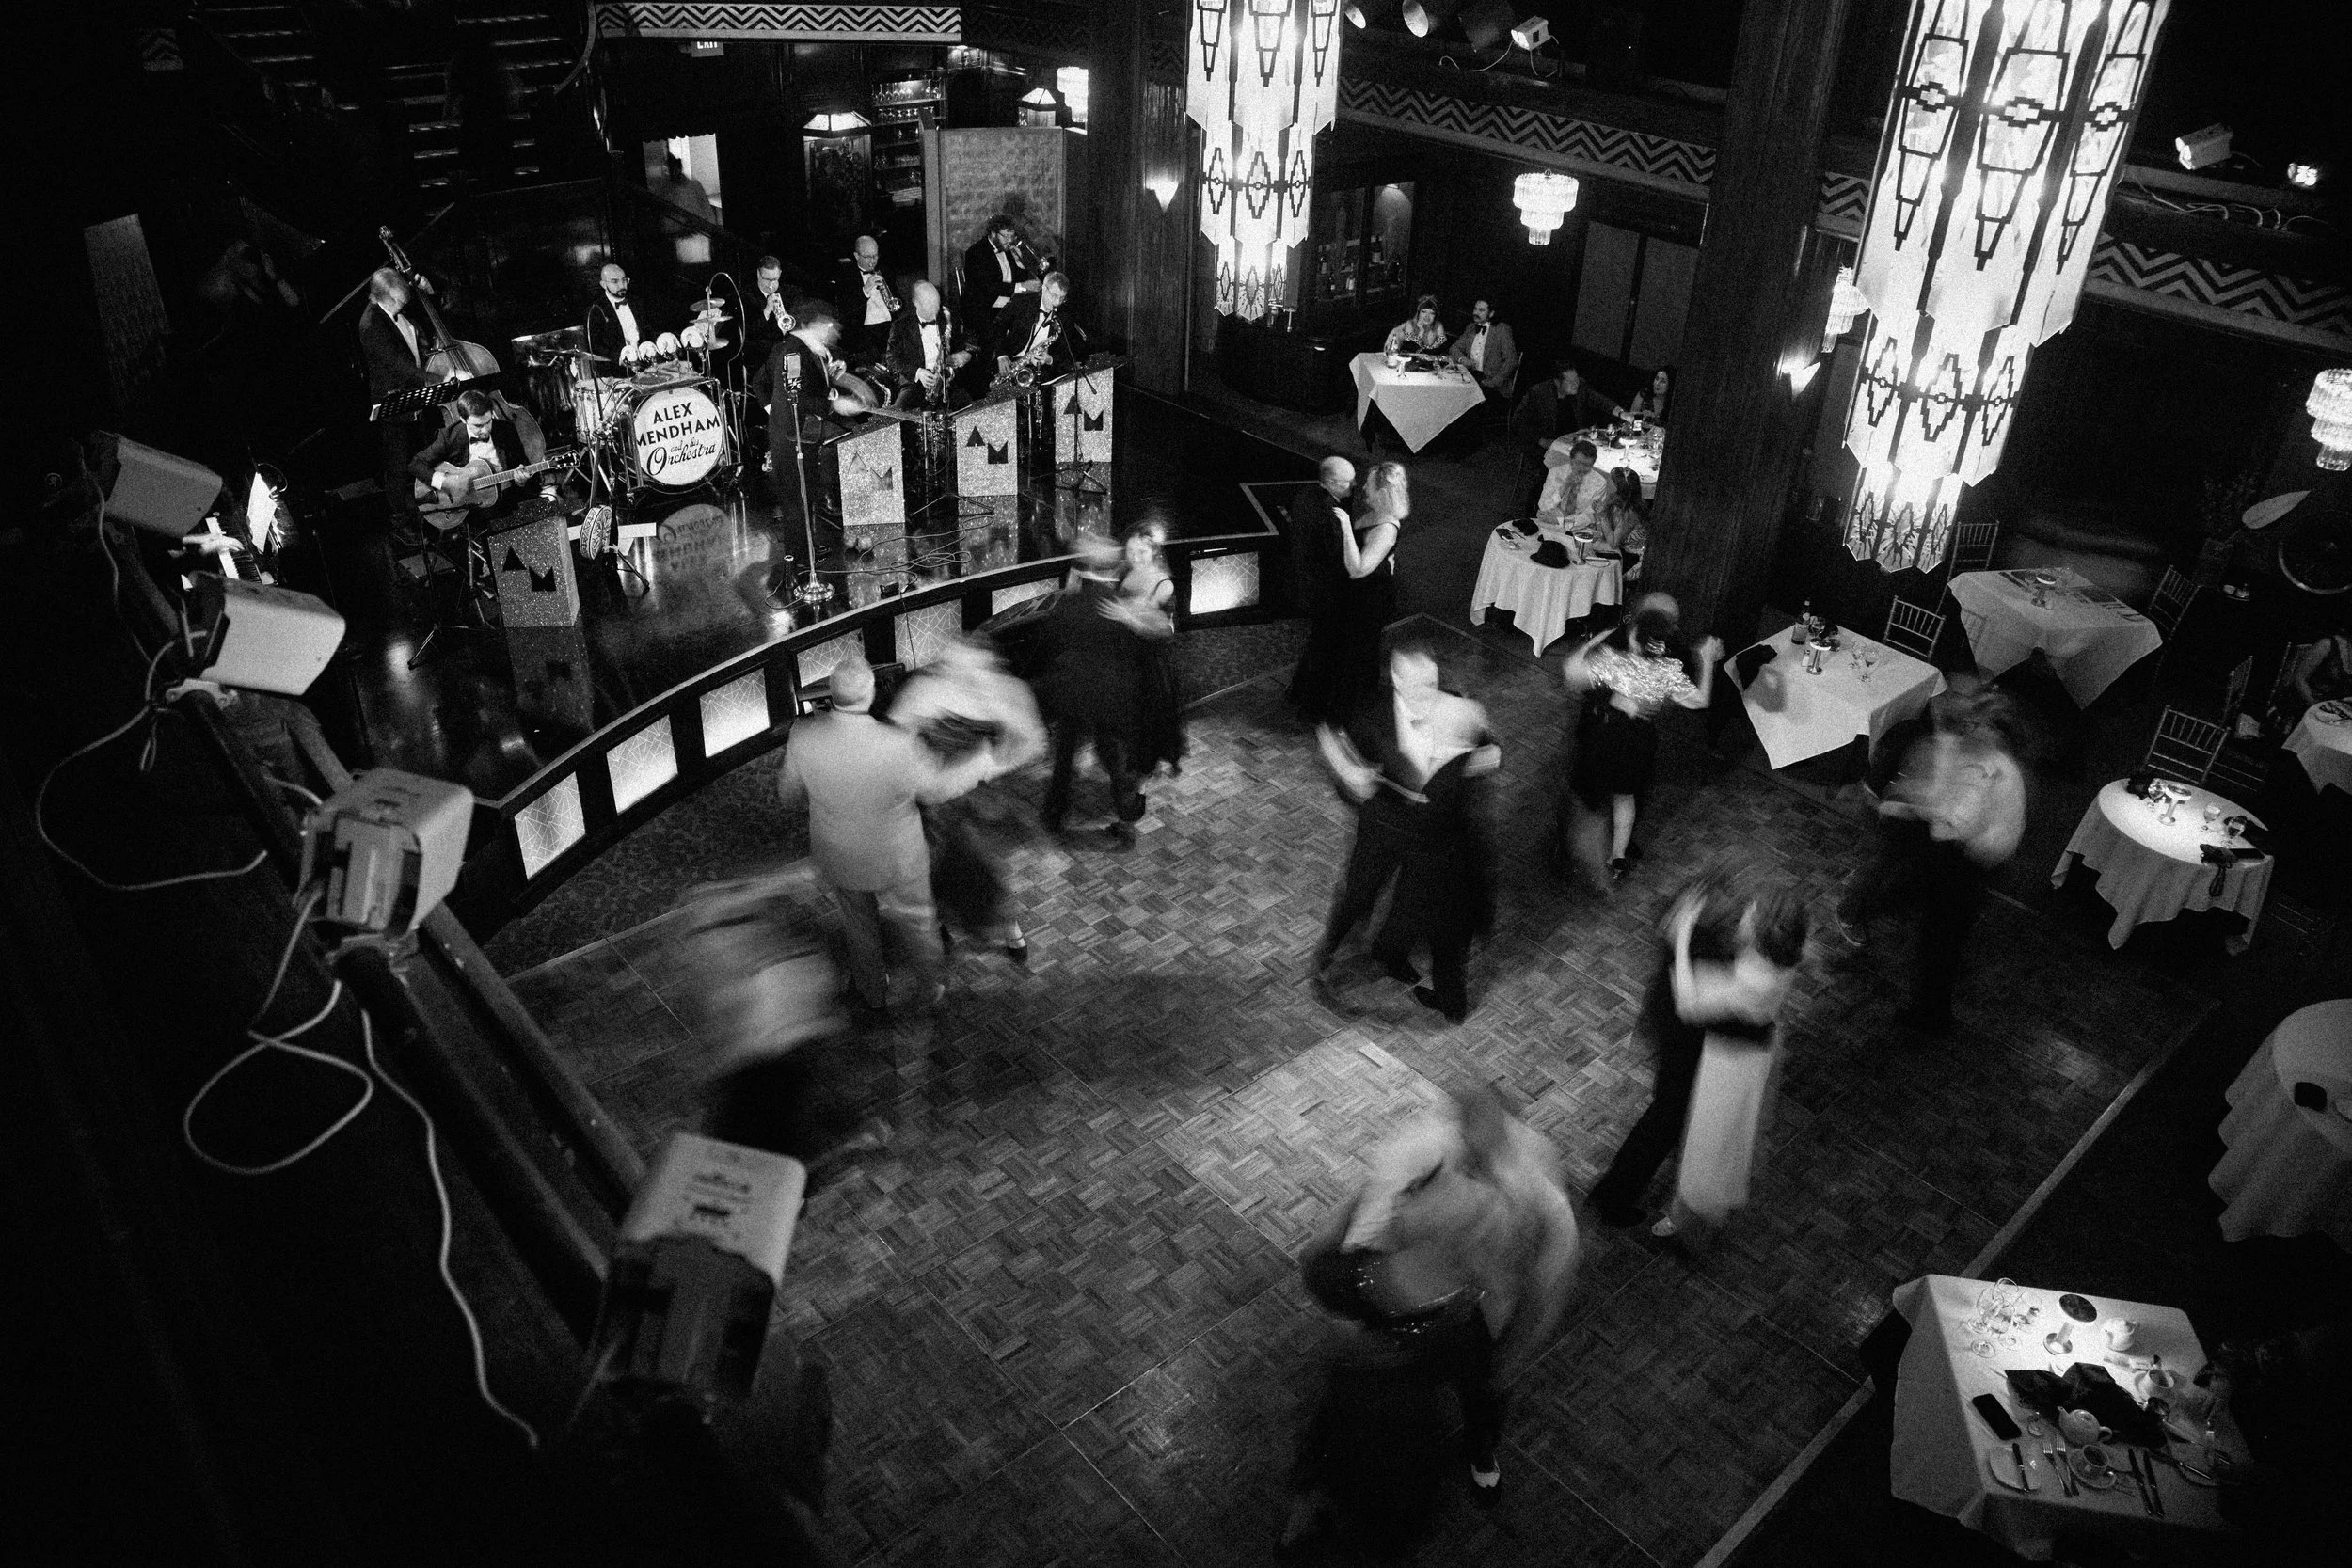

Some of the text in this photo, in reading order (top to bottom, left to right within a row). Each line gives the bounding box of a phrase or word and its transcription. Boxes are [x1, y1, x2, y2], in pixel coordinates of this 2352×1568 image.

[653, 402, 693, 424] ALEX
[670, 437, 700, 452] and his
[646, 443, 716, 476] Orchestra
